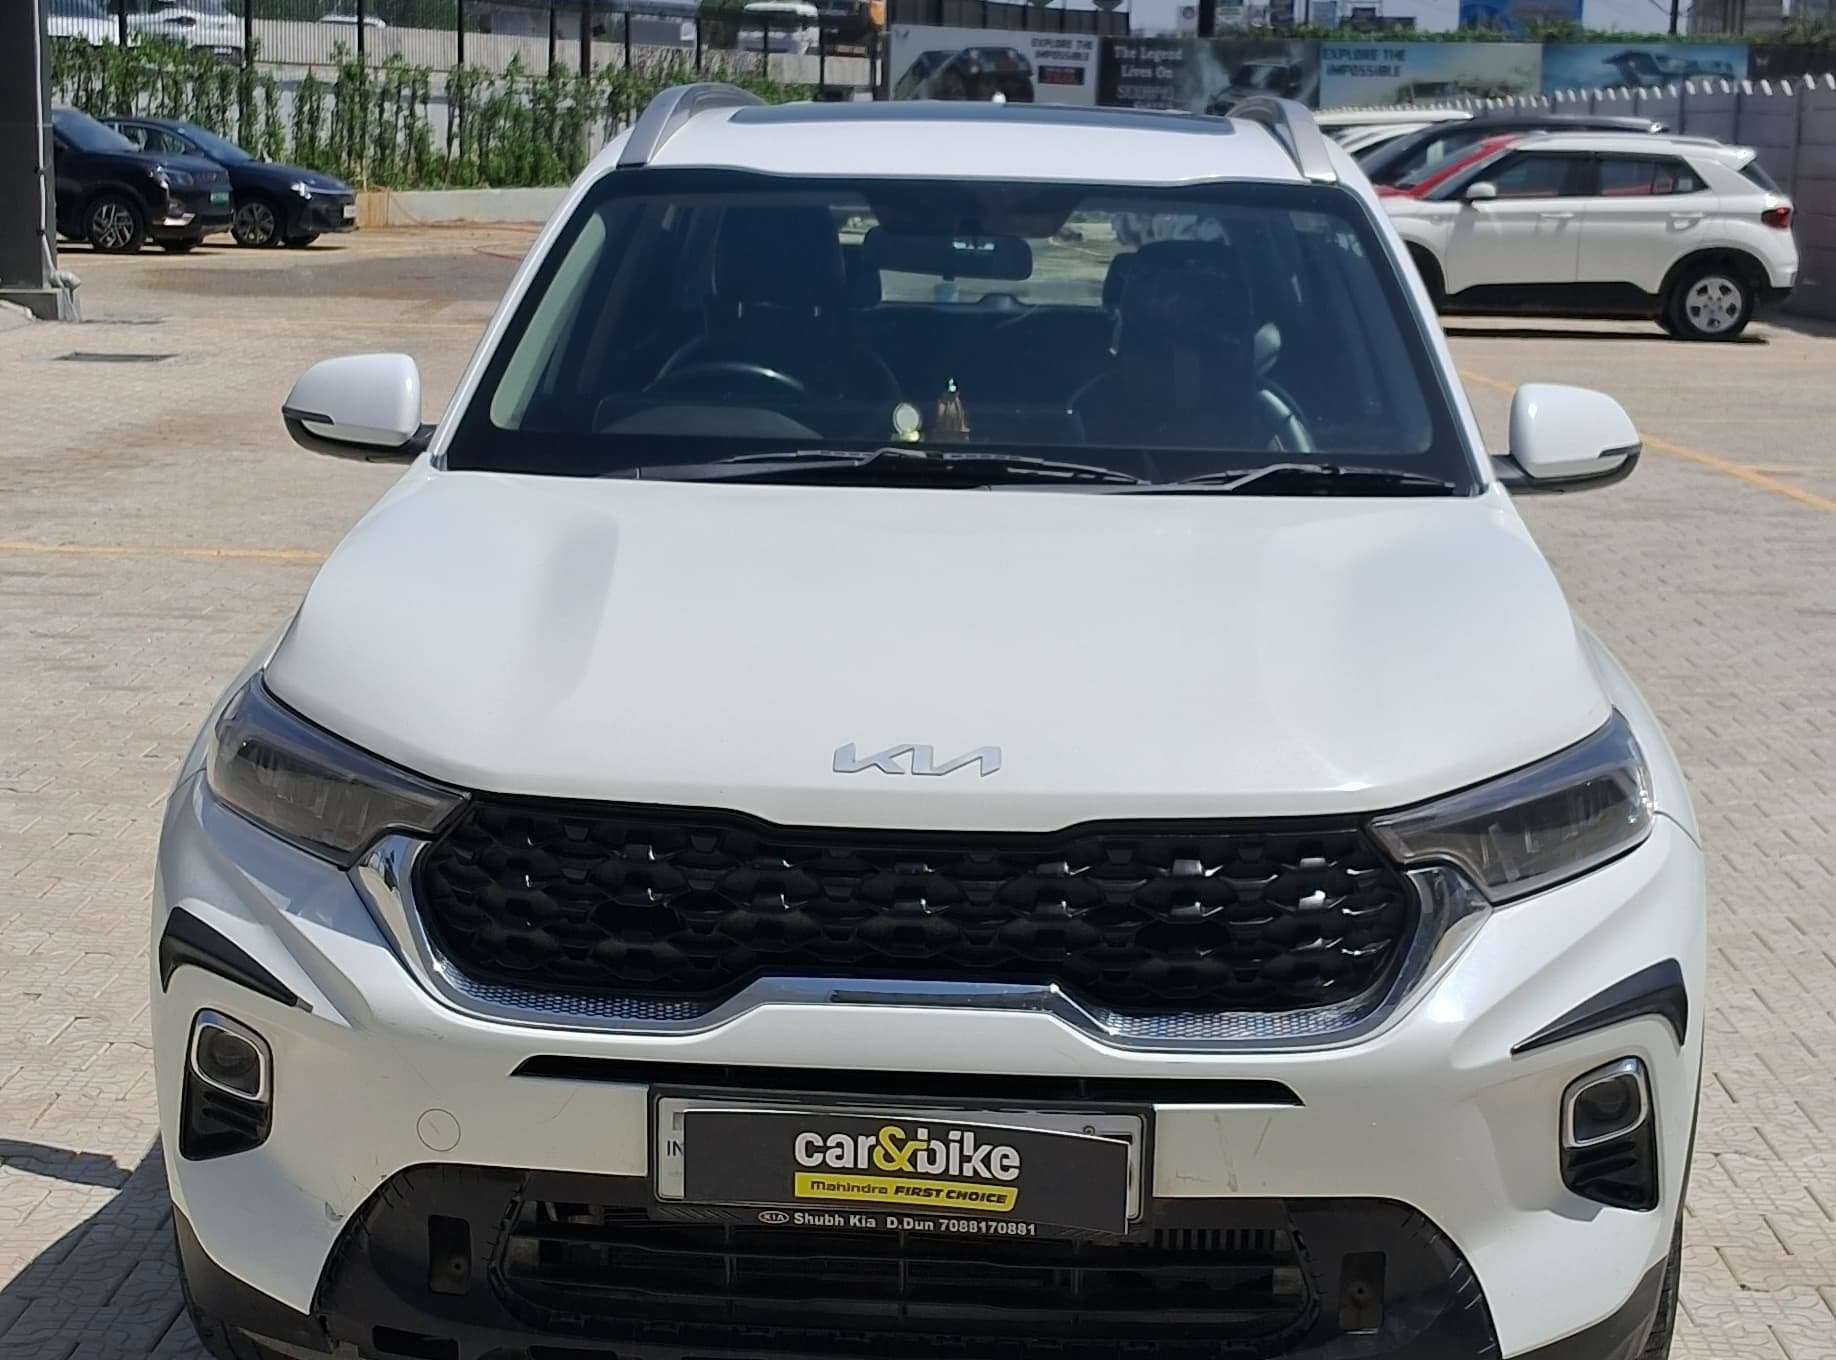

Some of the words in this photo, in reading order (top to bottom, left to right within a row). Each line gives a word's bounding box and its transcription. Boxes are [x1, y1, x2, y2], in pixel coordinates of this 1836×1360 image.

[1114, 46, 1137, 59] The
[1140, 47, 1183, 61] Legend
[1323, 48, 1377, 60] EXPLORE
[1382, 48, 1406, 60] THE
[1121, 66, 1150, 78] Lives
[1155, 65, 1174, 79] On
[1327, 64, 1400, 77] IMPOSSIBLE
[810, 1180, 888, 1195] Mahindra
[894, 1185, 945, 1198] FIRST
[945, 1189, 1008, 1205] CHOICE
[793, 1212, 845, 1227] Shubh
[850, 1213, 876, 1228] Kia
[886, 1216, 934, 1231] D.Dun
[938, 1218, 1036, 1236] 7088170881
